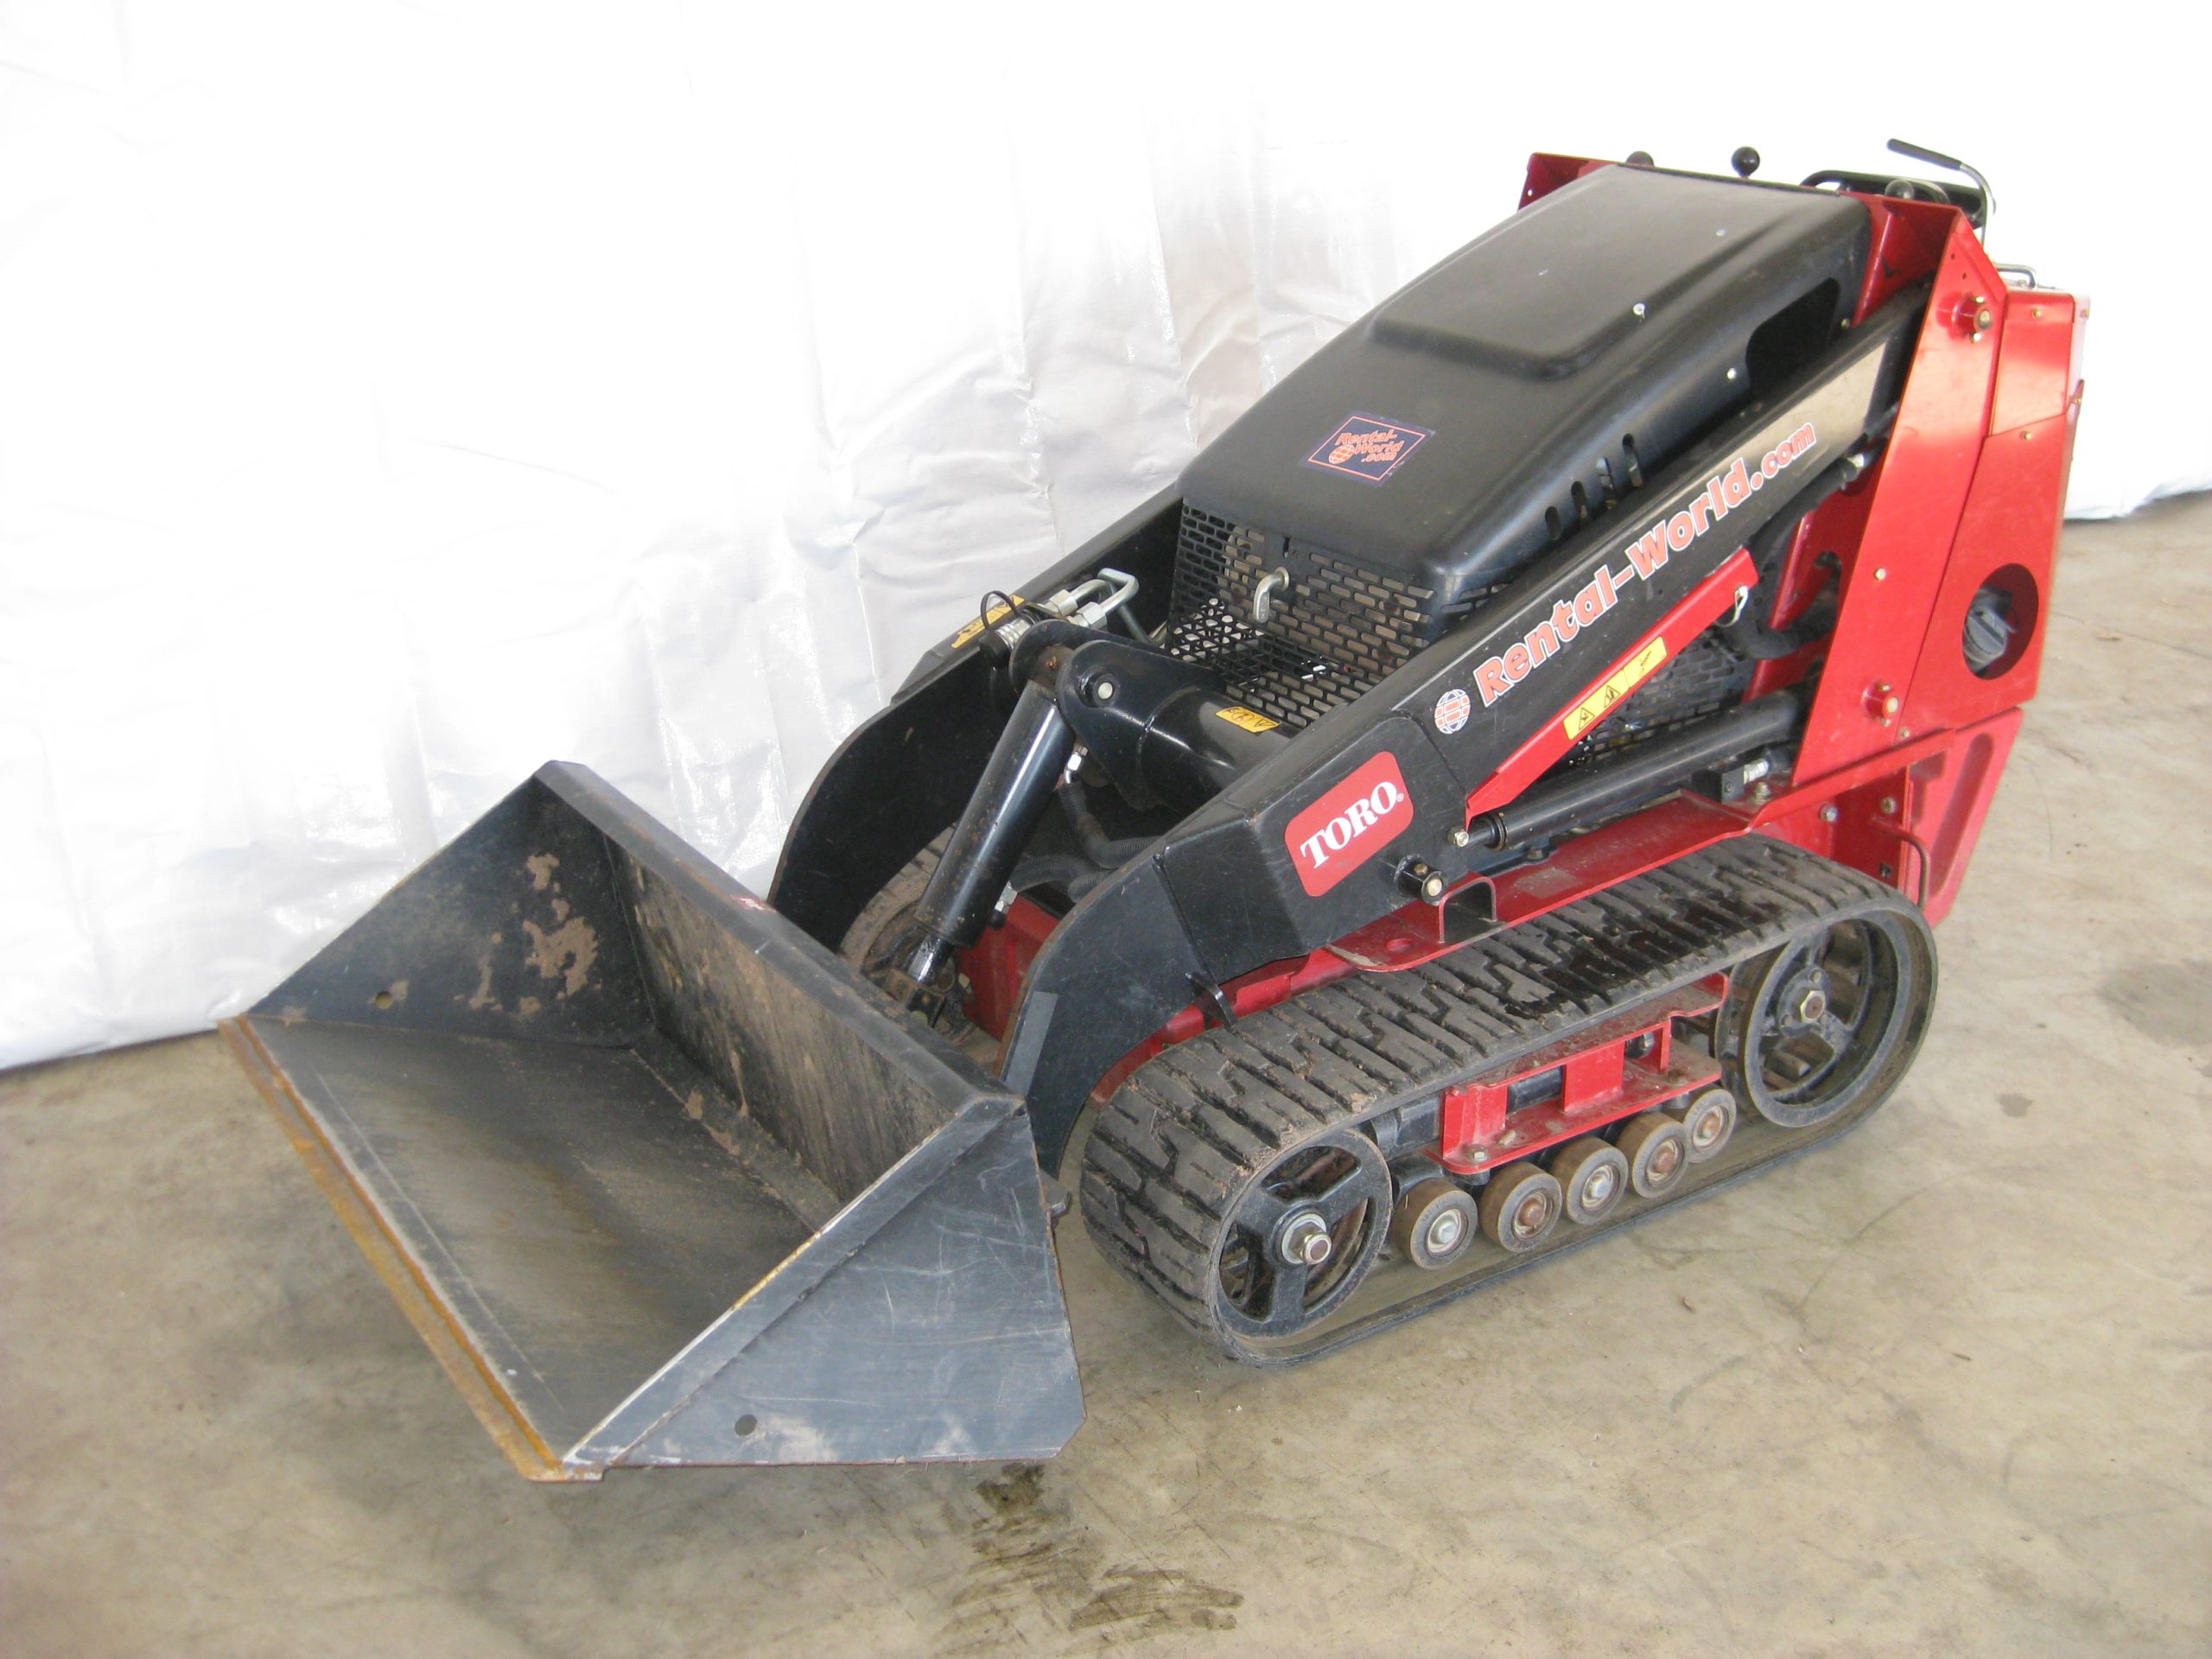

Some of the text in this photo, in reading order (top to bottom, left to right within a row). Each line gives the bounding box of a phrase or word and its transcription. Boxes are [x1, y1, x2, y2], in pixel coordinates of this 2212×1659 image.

[1335, 429, 1397, 445] Rental-
[1354, 441, 1405, 454] World
[1473, 423, 1816, 708] Rental-World.com
